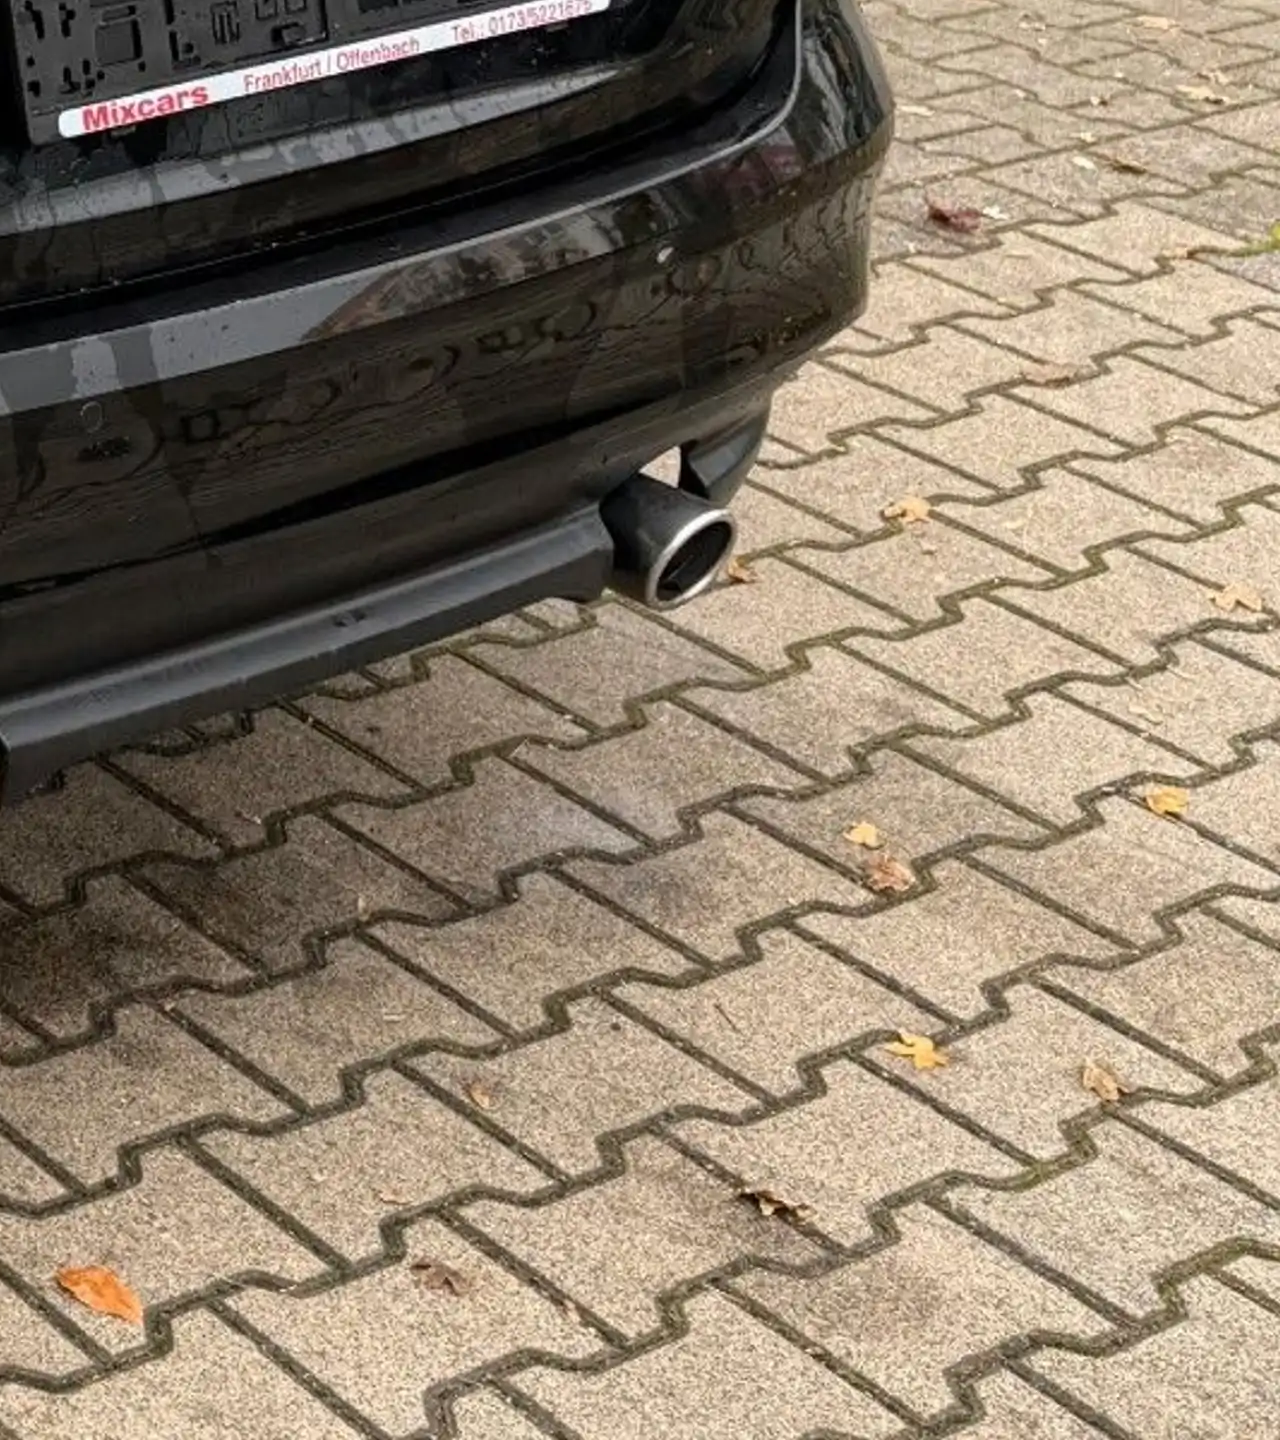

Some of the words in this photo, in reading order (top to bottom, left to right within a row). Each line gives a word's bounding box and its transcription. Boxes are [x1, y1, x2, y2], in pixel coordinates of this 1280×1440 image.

[81, 85, 209, 131] Mixcars
[244, 61, 322, 93] Frankfurt
[336, 36, 420, 71] Offenbach
